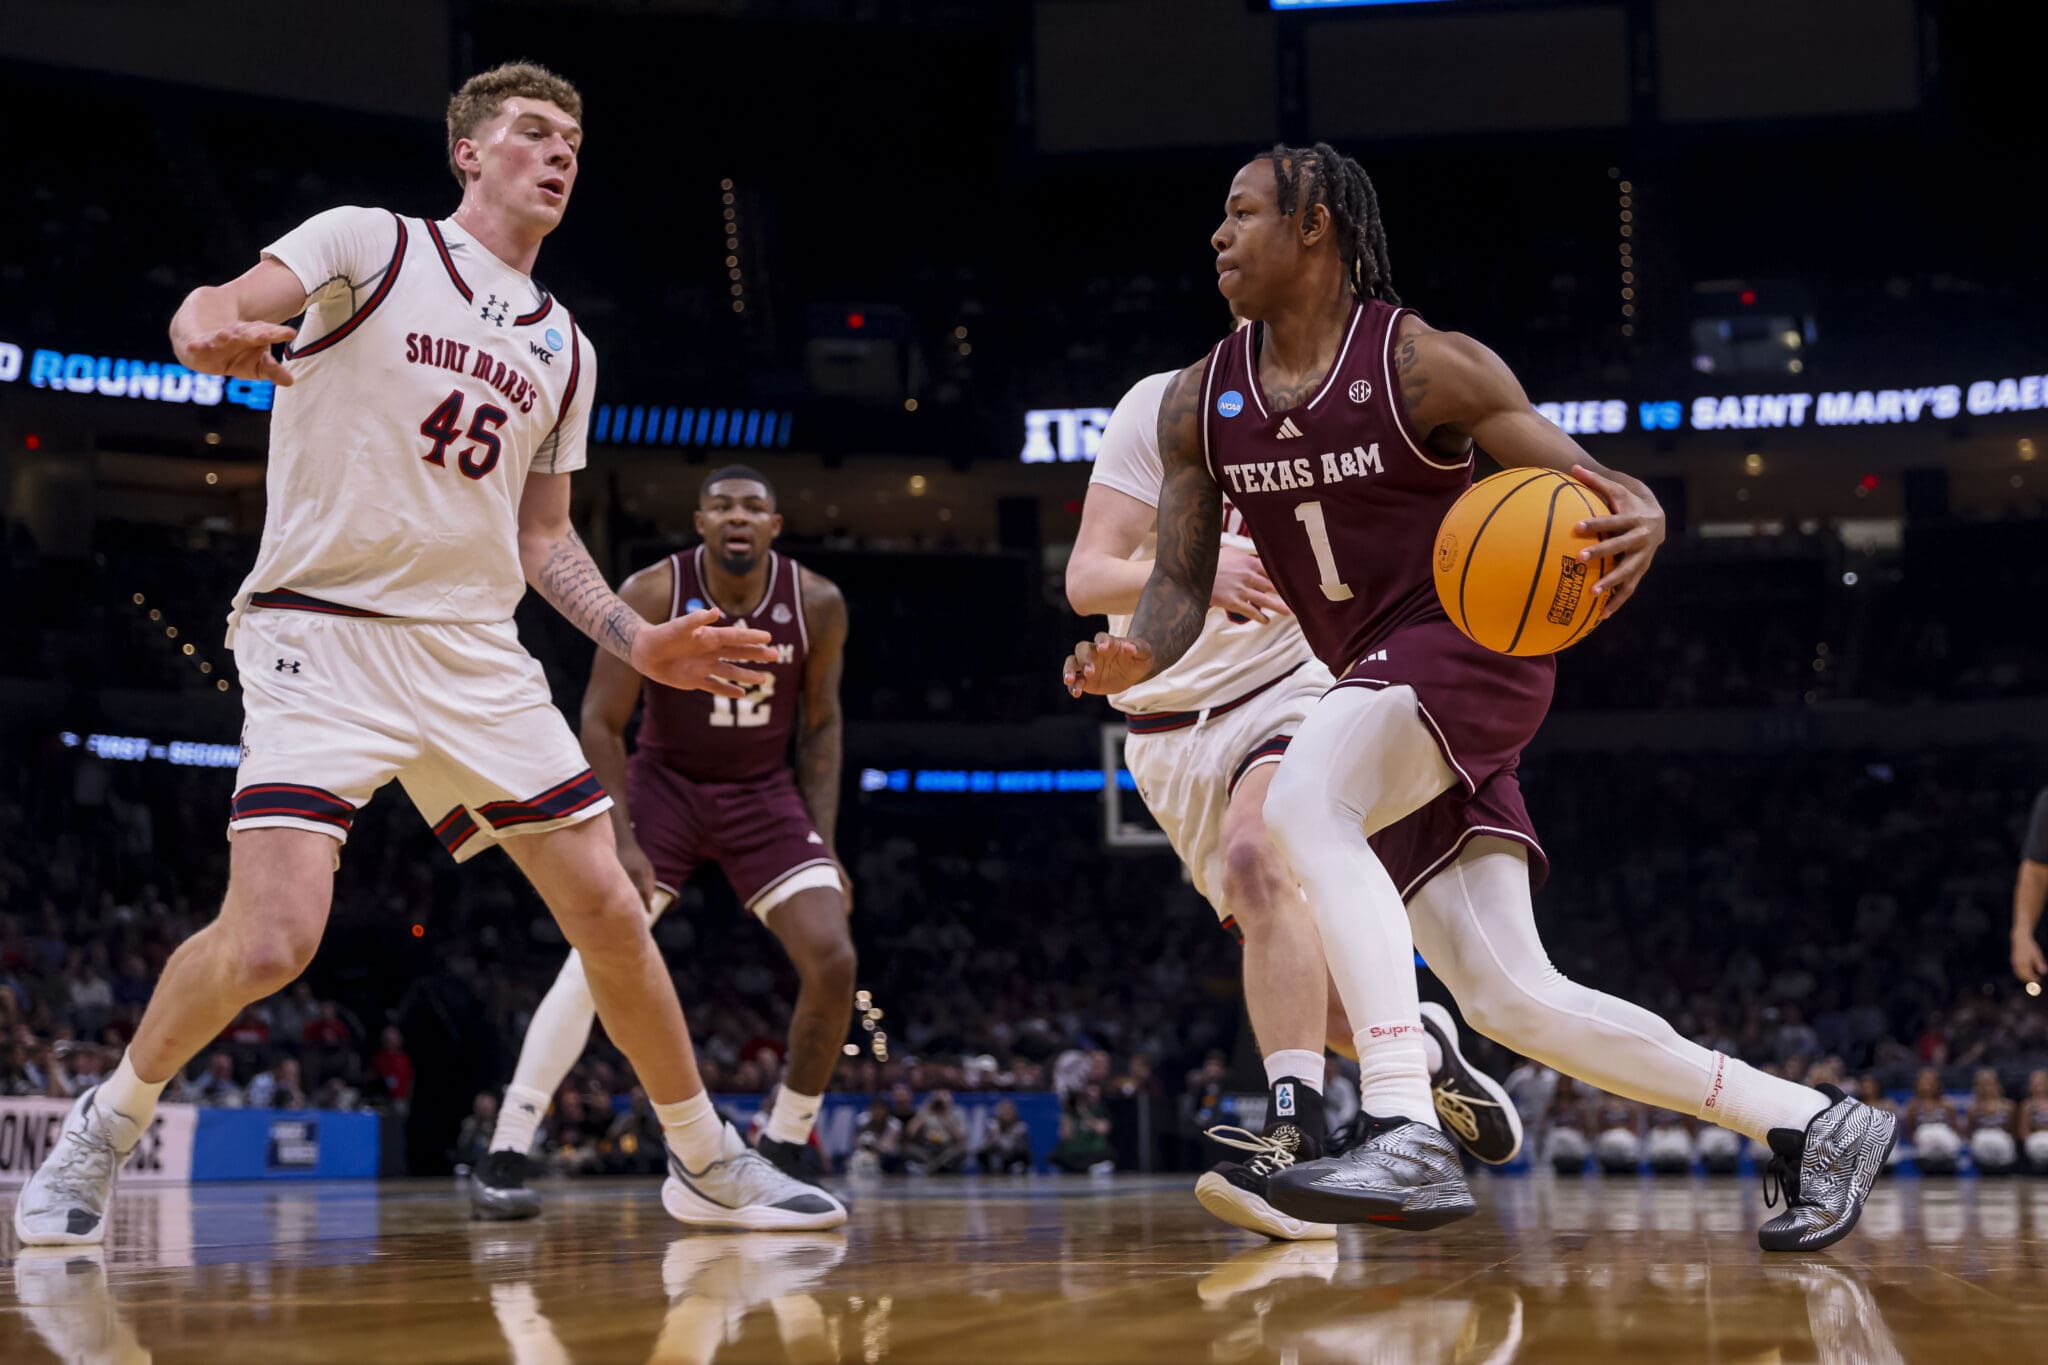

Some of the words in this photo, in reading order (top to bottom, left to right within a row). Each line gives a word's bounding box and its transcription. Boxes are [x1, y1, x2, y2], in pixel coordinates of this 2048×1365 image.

[405, 332, 470, 373] SAINT
[530, 340, 553, 365] WCC
[31, 349, 224, 406] ROUNDS
[1350, 381, 1370, 402] SEC
[1220, 401, 1241, 412] NCAA
[1639, 401, 1682, 430] VS
[1691, 393, 1812, 429] SAINT
[1815, 384, 1962, 425] MARY'S
[420, 389, 508, 480] 45
[1223, 458, 1314, 493] TEXAS
[1320, 443, 1385, 484] A&M
[1294, 501, 1354, 601] 1
[1550, 578, 1573, 623] MADNESS
[1567, 574, 1584, 610] MARCH
